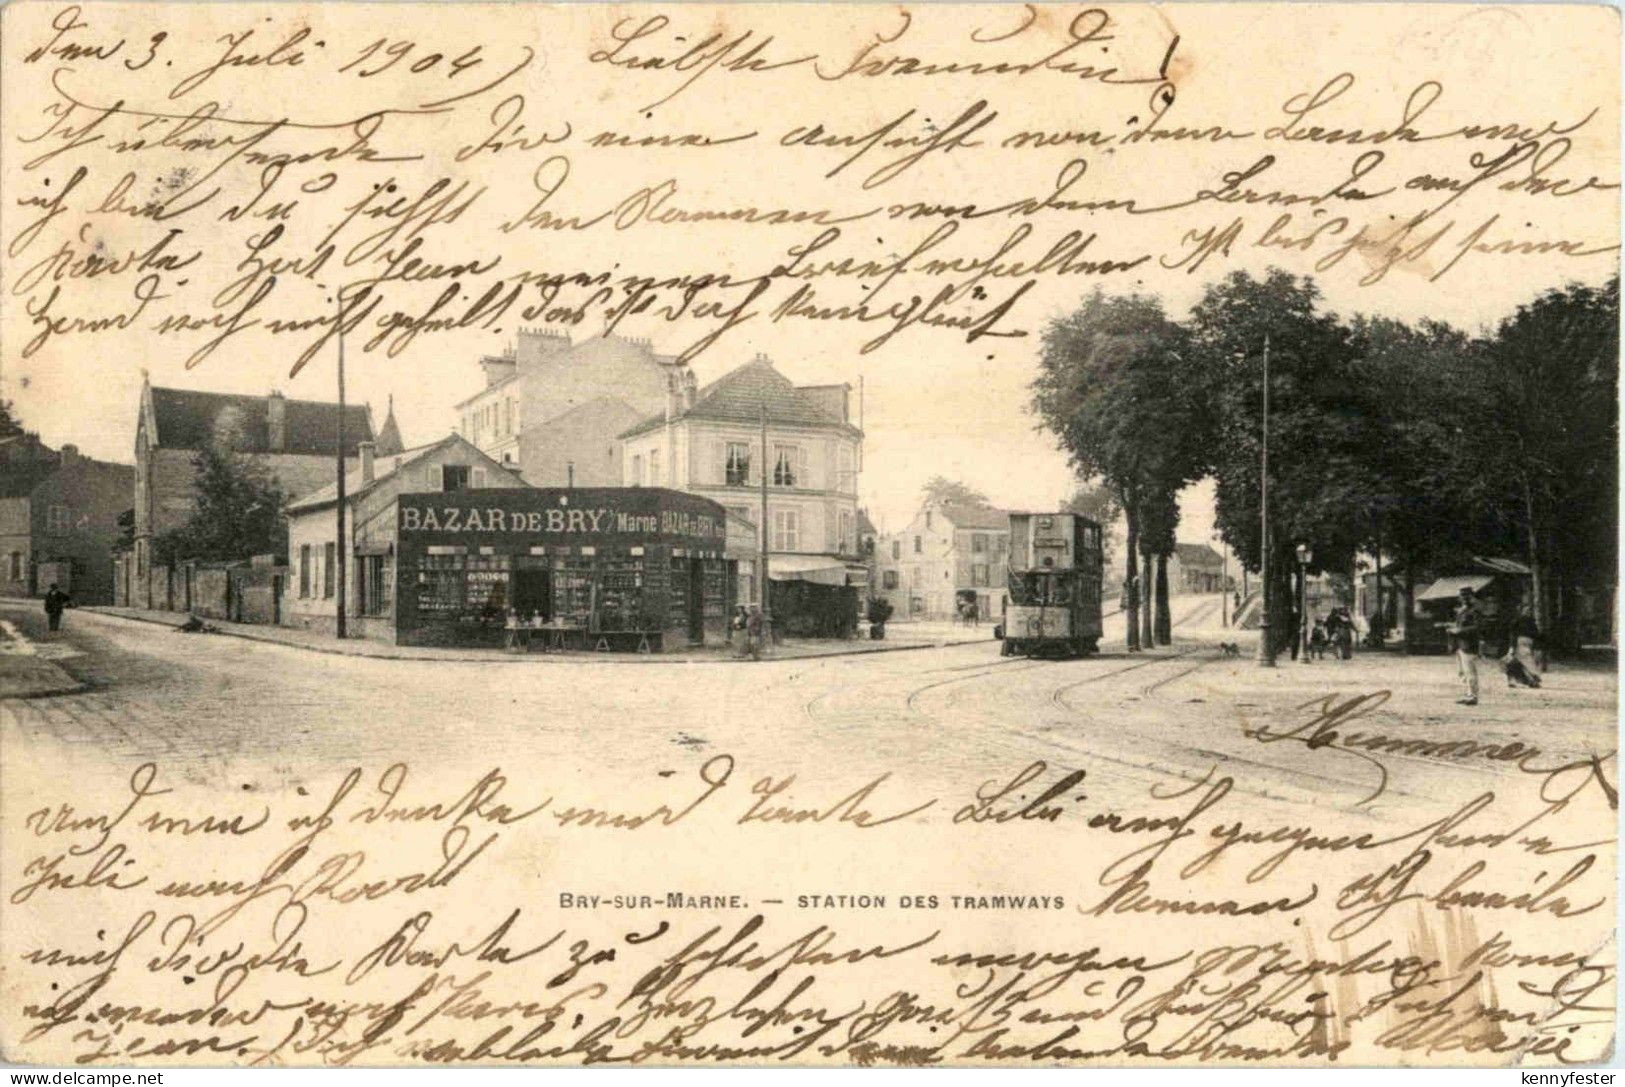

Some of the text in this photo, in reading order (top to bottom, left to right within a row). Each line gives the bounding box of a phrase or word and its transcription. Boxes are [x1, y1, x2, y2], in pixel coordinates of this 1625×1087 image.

[338, 37, 483, 78] 1904
[401, 508, 507, 533] BAZAR
[511, 511, 542, 532] DE
[546, 508, 606, 533] BRY
[617, 511, 657, 533] Marne
[798, 892, 888, 910] STATION
[900, 892, 940, 910] DES
[951, 892, 1066, 910] TRAMWAYS
